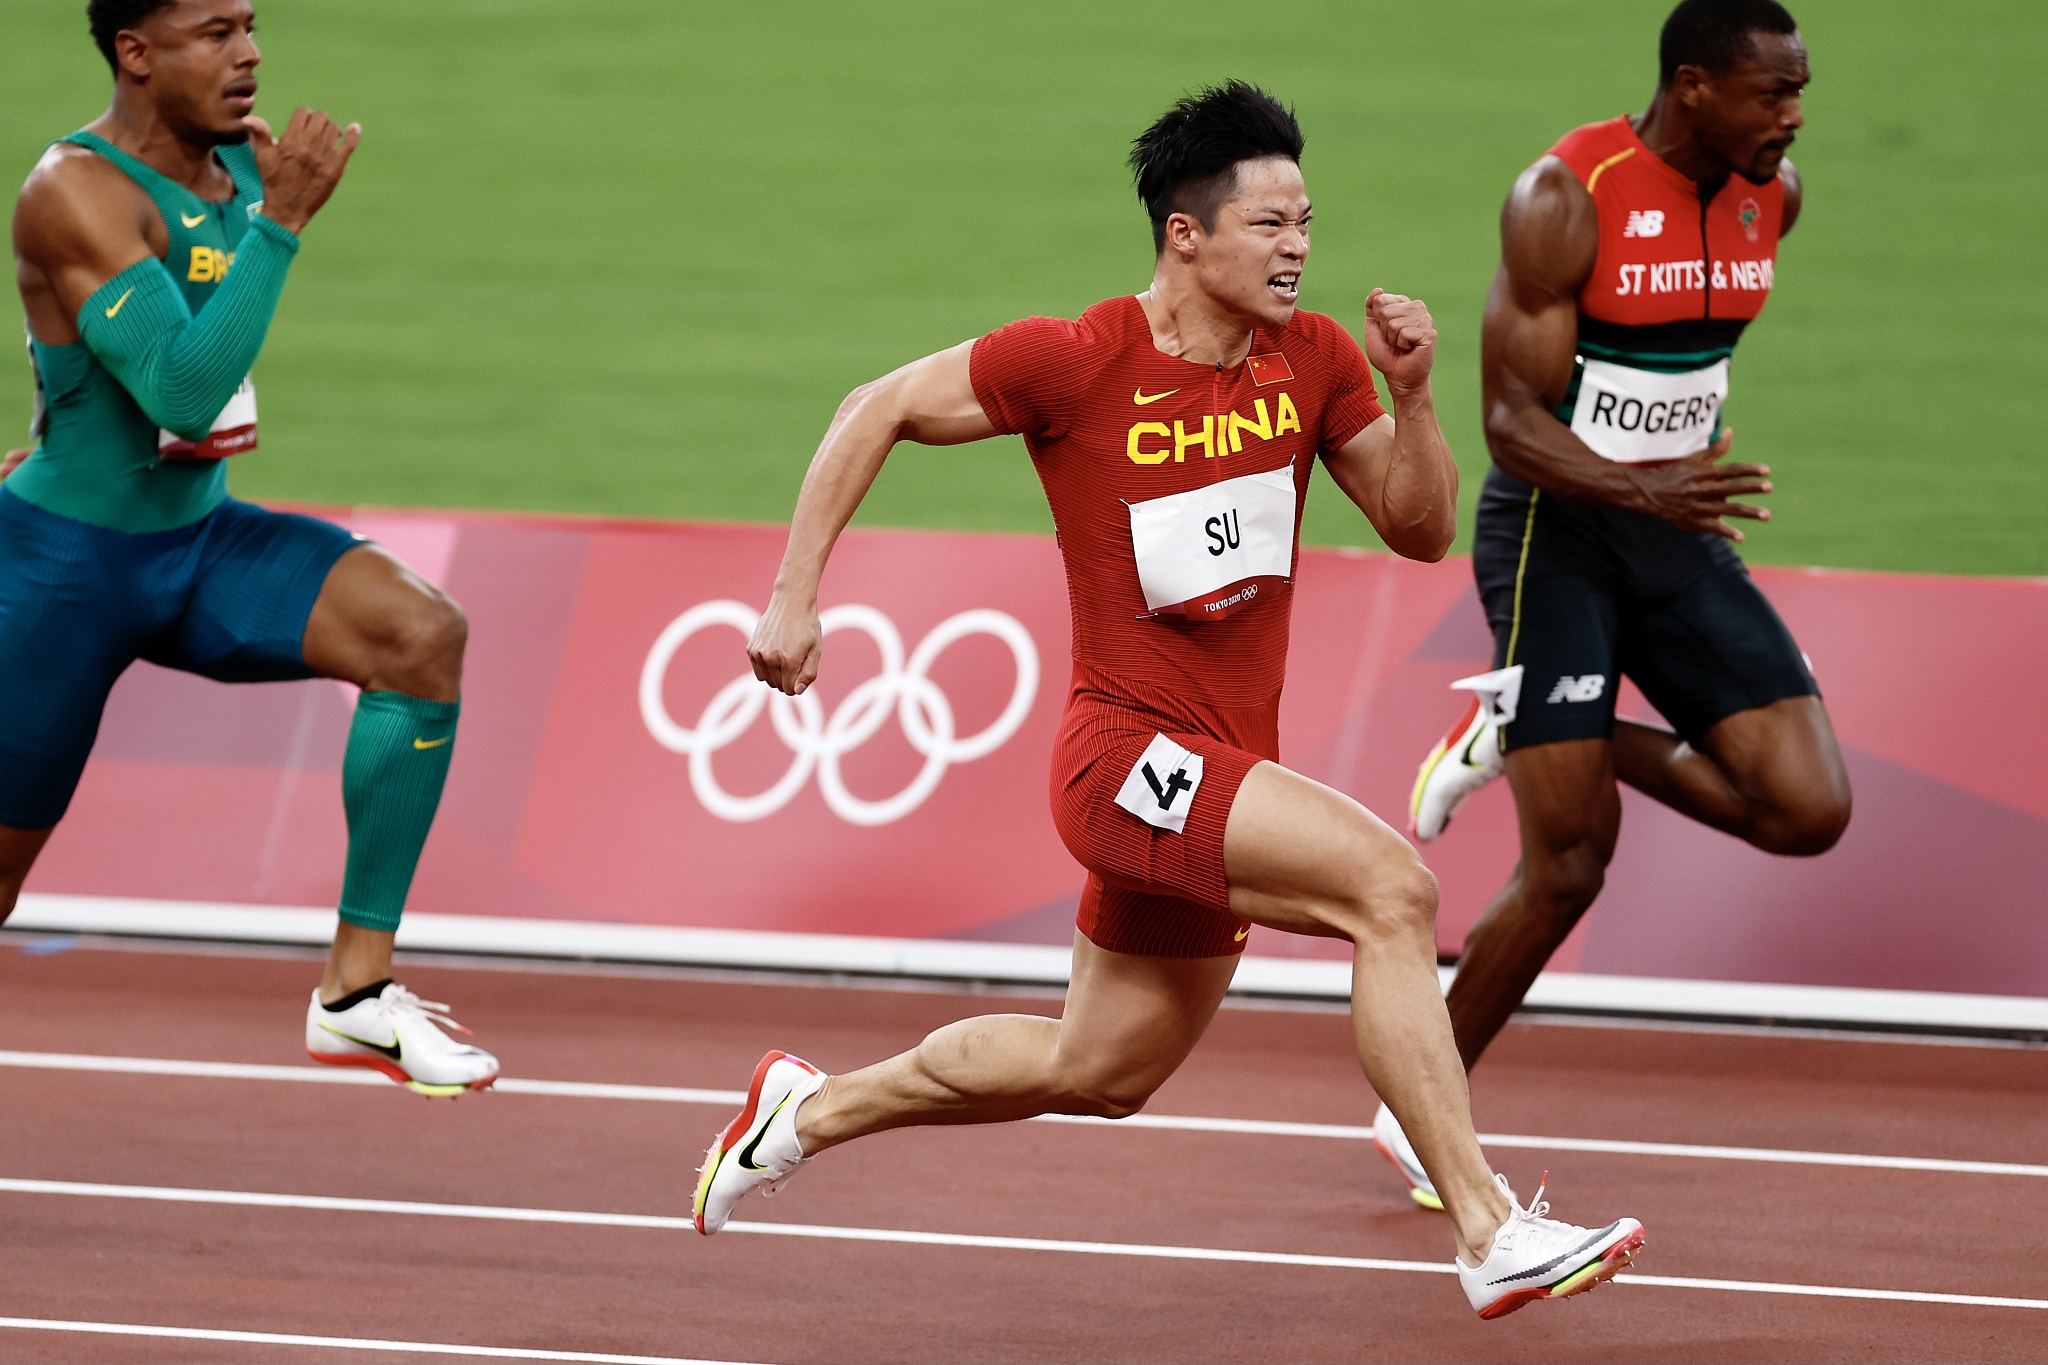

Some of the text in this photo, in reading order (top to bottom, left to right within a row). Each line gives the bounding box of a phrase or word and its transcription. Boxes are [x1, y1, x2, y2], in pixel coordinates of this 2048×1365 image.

[1615, 263, 1647, 296] ST
[1650, 259, 1706, 294] KITTS
[1711, 260, 1728, 290] &
[1126, 392, 1302, 465] CHINA
[1592, 389, 1717, 434] ROGERS
[1204, 508, 1241, 557] SU
[1203, 593, 1241, 613] TOKYO 2020
[1141, 761, 1193, 812] 4
